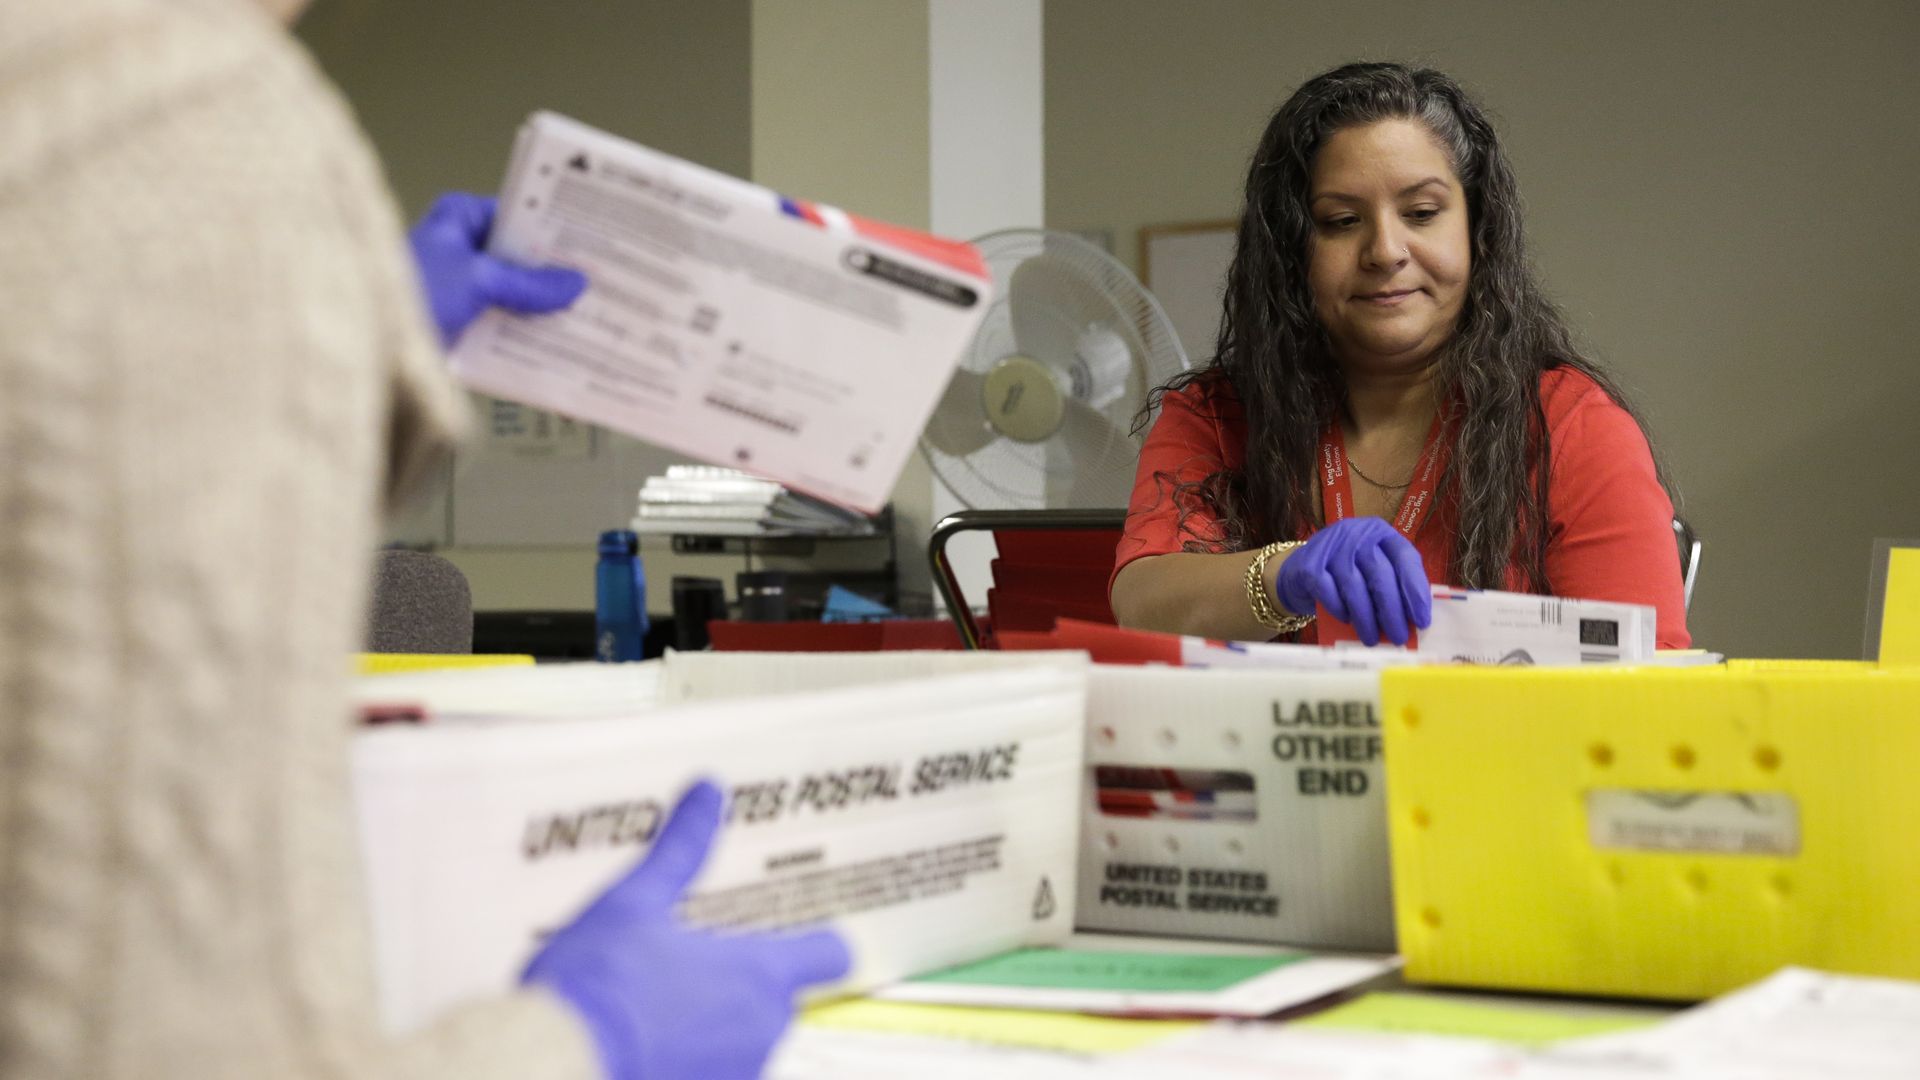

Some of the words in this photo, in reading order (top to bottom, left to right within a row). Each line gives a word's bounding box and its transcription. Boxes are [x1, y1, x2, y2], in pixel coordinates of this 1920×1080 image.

[1324, 443, 1333, 469] County
[1334, 446, 1343, 478] Elections
[1327, 468, 1336, 486] King
[1398, 496, 1416, 525] Elections
[1414, 490, 1428, 508] King
[1403, 508, 1420, 533] County
[1272, 700, 1380, 728] LABEL
[1297, 768, 1369, 796] END
[524, 799, 664, 859] UNITED
[726, 782, 790, 824] TES
[794, 766, 899, 812] POSTAL
[910, 745, 1019, 796] SERVICE
[1104, 863, 1182, 887] UNITED
[1188, 868, 1268, 893] STATES
[1100, 885, 1181, 910] POSTAL
[1187, 892, 1280, 918] SERVICE
